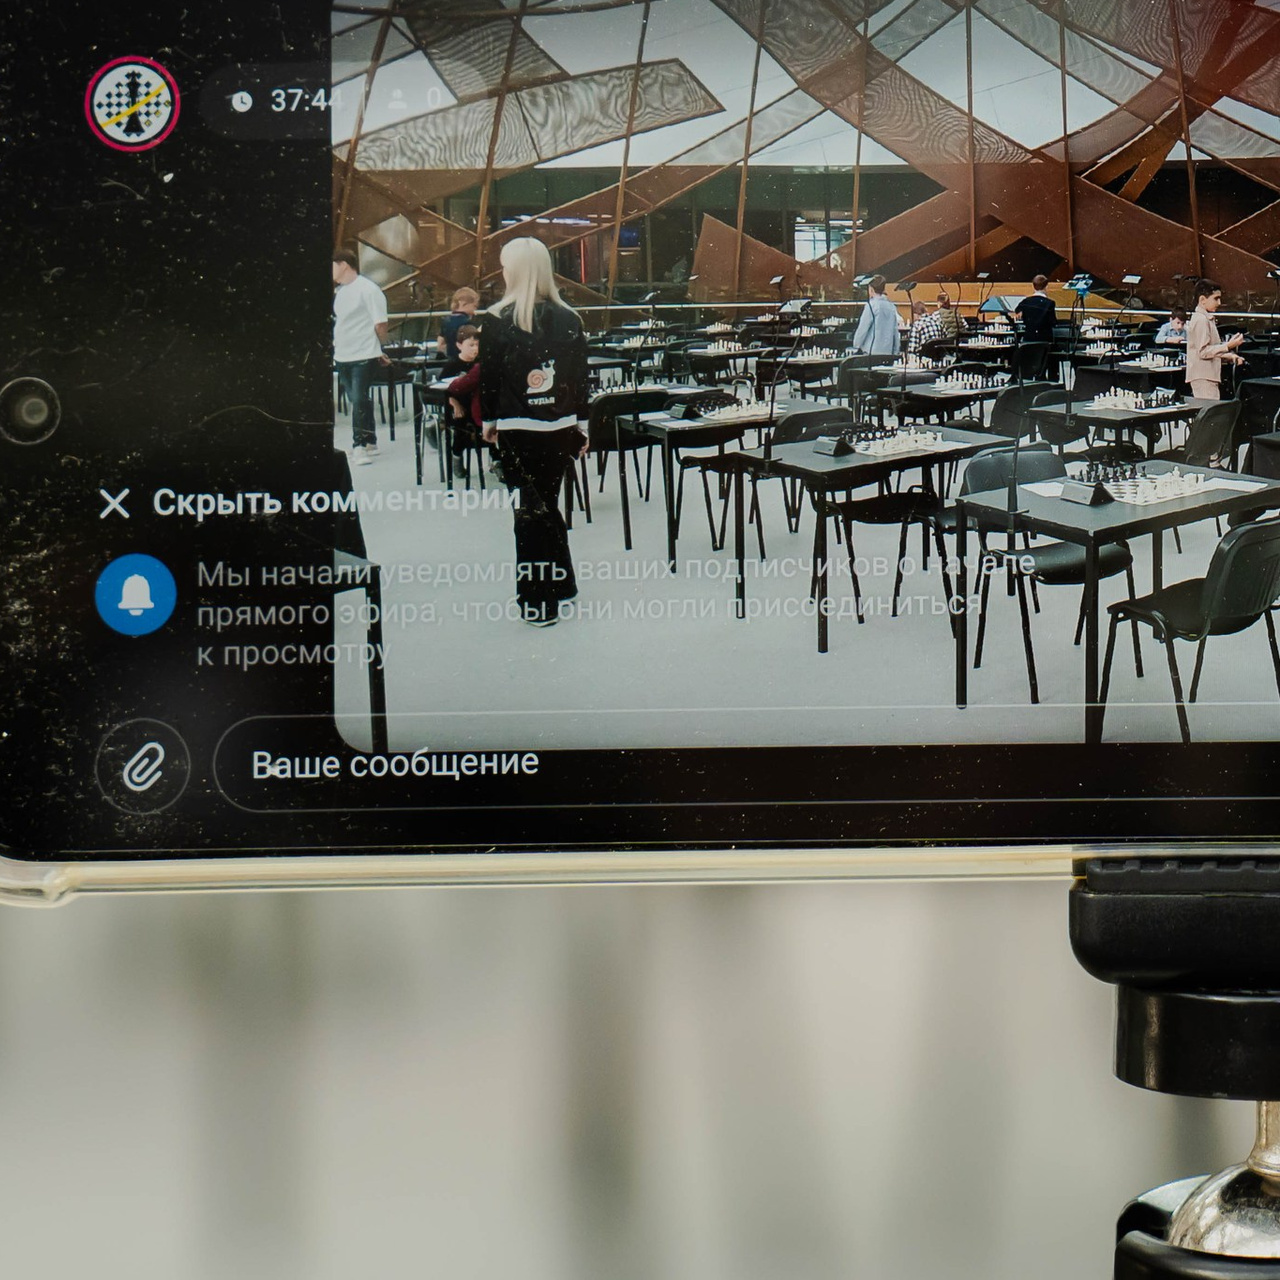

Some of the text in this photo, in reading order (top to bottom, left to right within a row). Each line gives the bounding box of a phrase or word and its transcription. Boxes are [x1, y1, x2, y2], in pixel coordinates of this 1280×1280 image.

[153, 487, 521, 521] Скрыть комментарии
[198, 561, 250, 586] Мы
[261, 562, 372, 585] начали
[379, 559, 568, 590] уведомлять
[577, 558, 676, 580] ваших
[686, 556, 889, 584] подписчиков
[198, 604, 330, 628] прямого
[452, 593, 546, 622] чтобы
[558, 600, 612, 620] они
[624, 597, 719, 619] могли
[727, 592, 982, 621] присоединиться
[198, 642, 391, 671] к просмотру
[253, 746, 539, 781] Ваше сообщение
